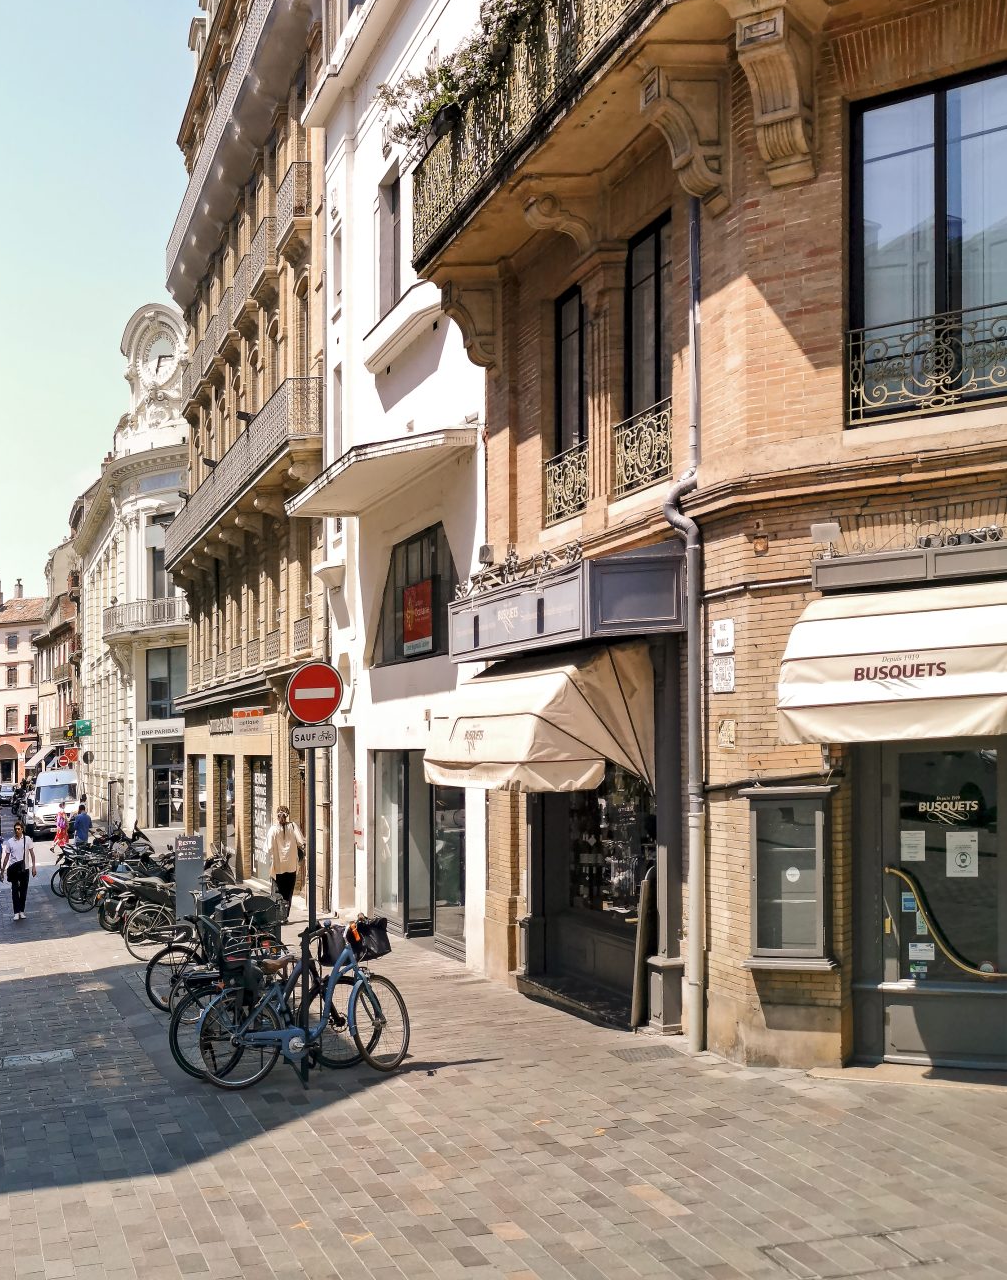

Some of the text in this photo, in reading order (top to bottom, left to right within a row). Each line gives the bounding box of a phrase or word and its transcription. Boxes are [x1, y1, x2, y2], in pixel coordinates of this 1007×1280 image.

[881, 655, 902, 663] Depuis
[854, 661, 947, 681] BUSQUETS
[294, 733, 317, 742] SAUF
[918, 800, 979, 813] BUSQUETS
